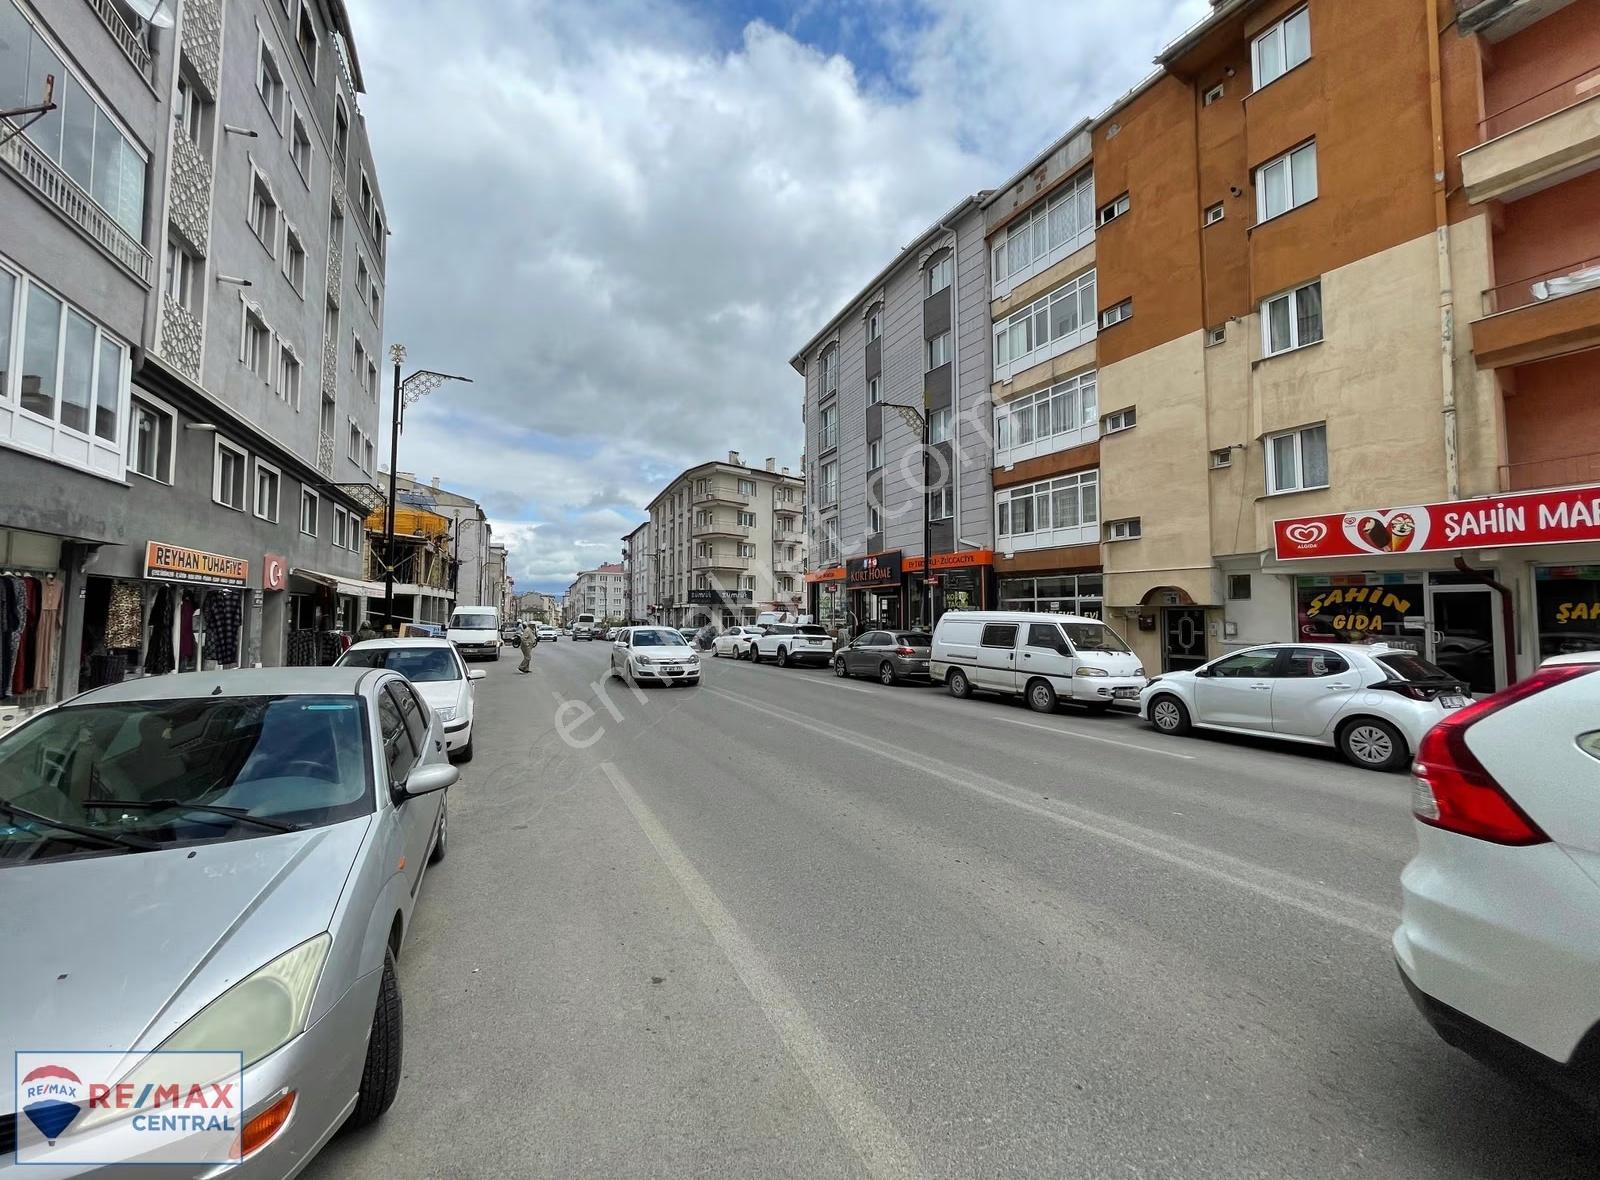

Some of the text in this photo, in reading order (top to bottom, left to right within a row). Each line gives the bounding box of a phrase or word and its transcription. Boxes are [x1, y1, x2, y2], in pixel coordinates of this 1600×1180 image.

[1444, 503, 1525, 542] ŞAHİN
[156, 547, 242, 576] REYHAN TUHAFİYE
[850, 570, 868, 583] KURT
[868, 567, 892, 580] HOME
[1306, 587, 1411, 618] ŞAHİN
[1333, 614, 1382, 631] GIDA
